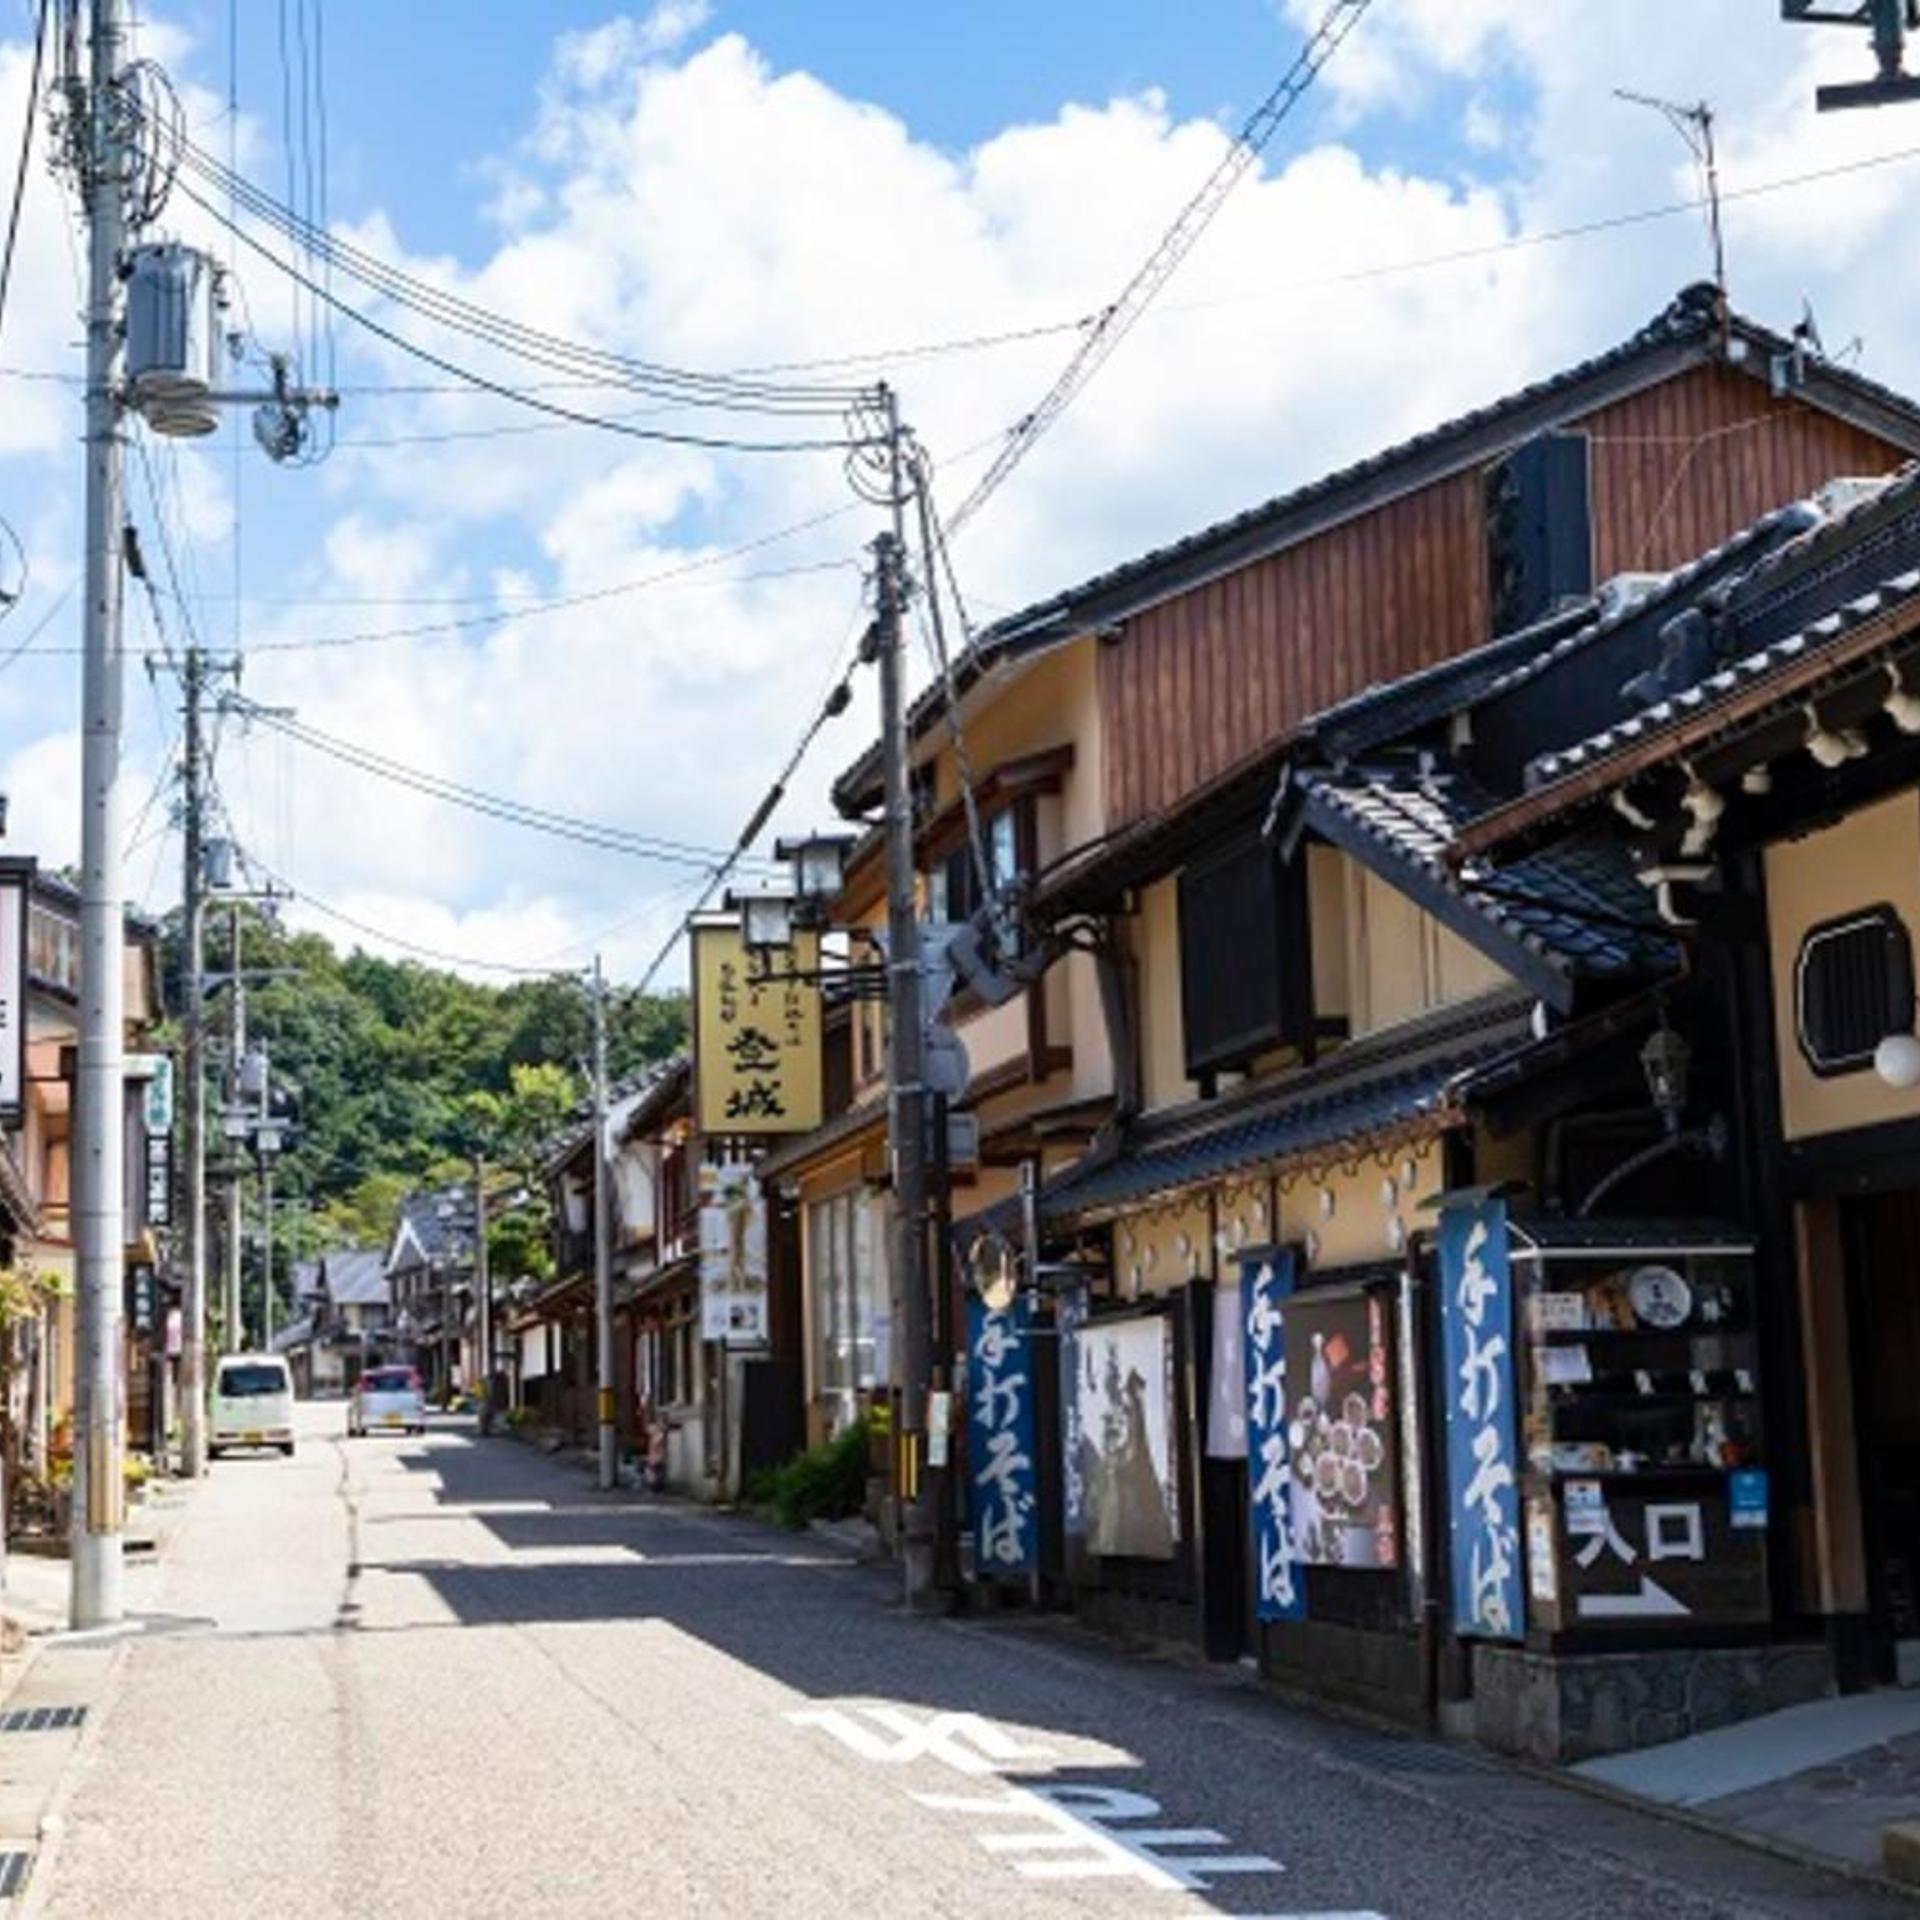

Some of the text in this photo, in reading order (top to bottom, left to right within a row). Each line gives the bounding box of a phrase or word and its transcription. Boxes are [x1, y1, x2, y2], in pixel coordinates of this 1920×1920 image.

[725, 1026, 786, 1119] 登城
[1573, 1502, 1706, 1569] 入口
[782, 1709, 1388, 1920] まれ
